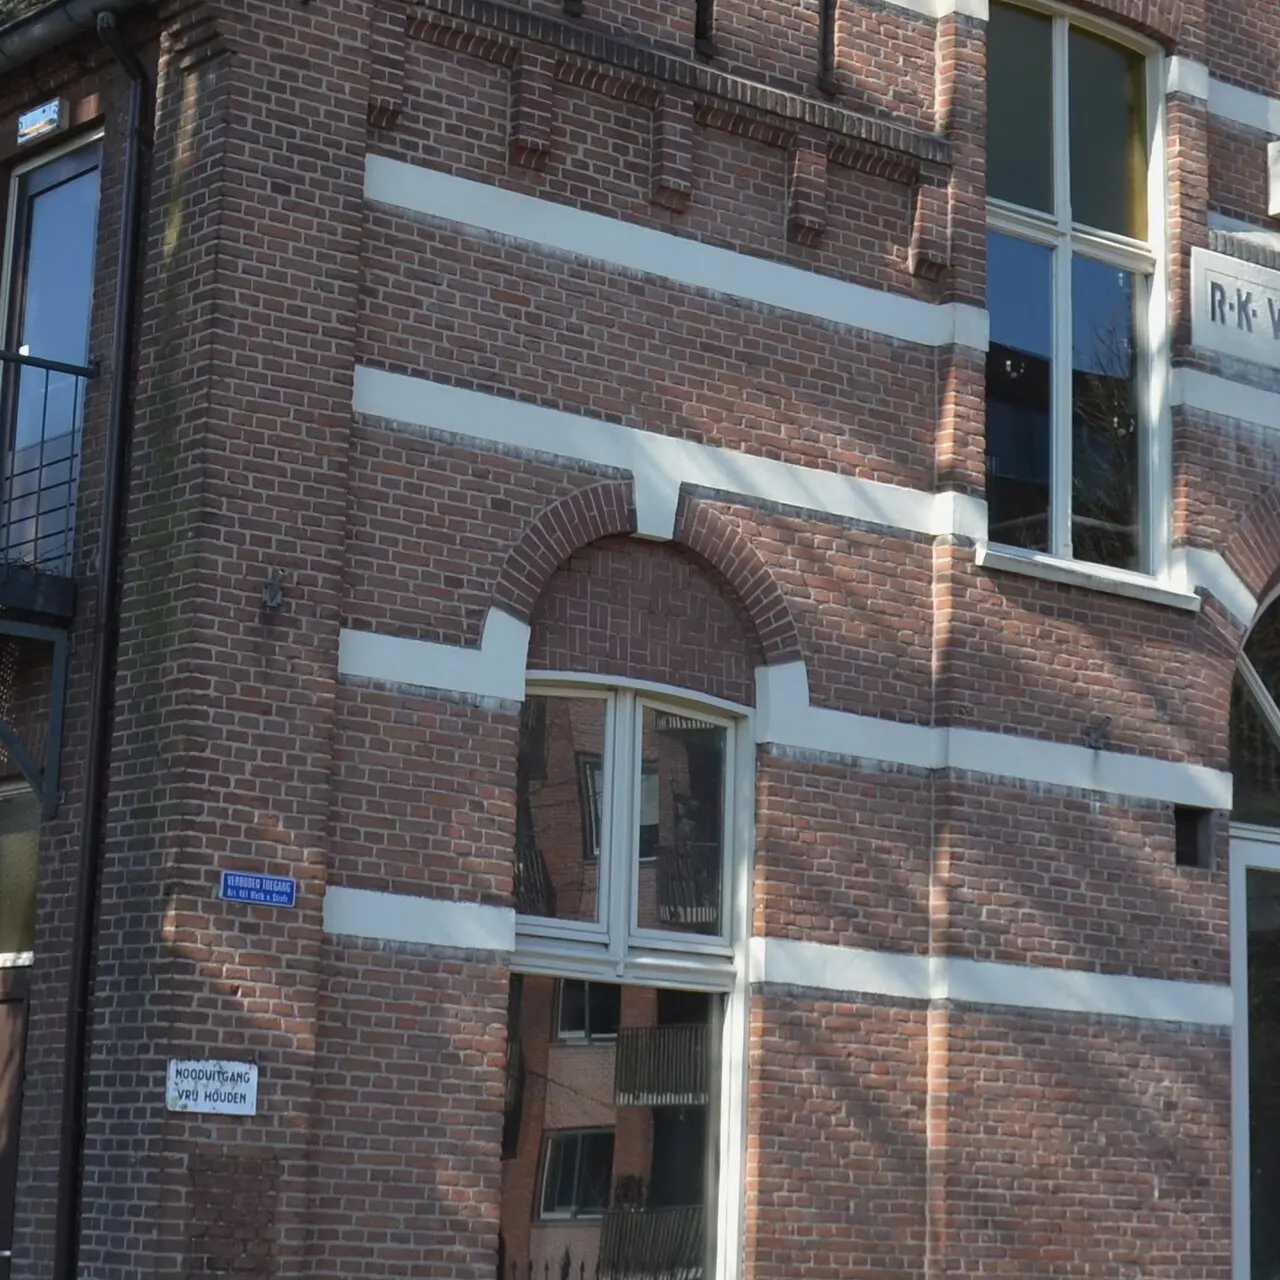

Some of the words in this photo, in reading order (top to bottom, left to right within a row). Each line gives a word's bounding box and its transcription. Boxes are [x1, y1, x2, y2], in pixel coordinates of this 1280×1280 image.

[226, 874, 261, 889] VERBODEN
[262, 878, 292, 893] TOEGANG
[175, 1068, 251, 1084] NOODUITGANG
[204, 1090, 247, 1104] HOUDEN
